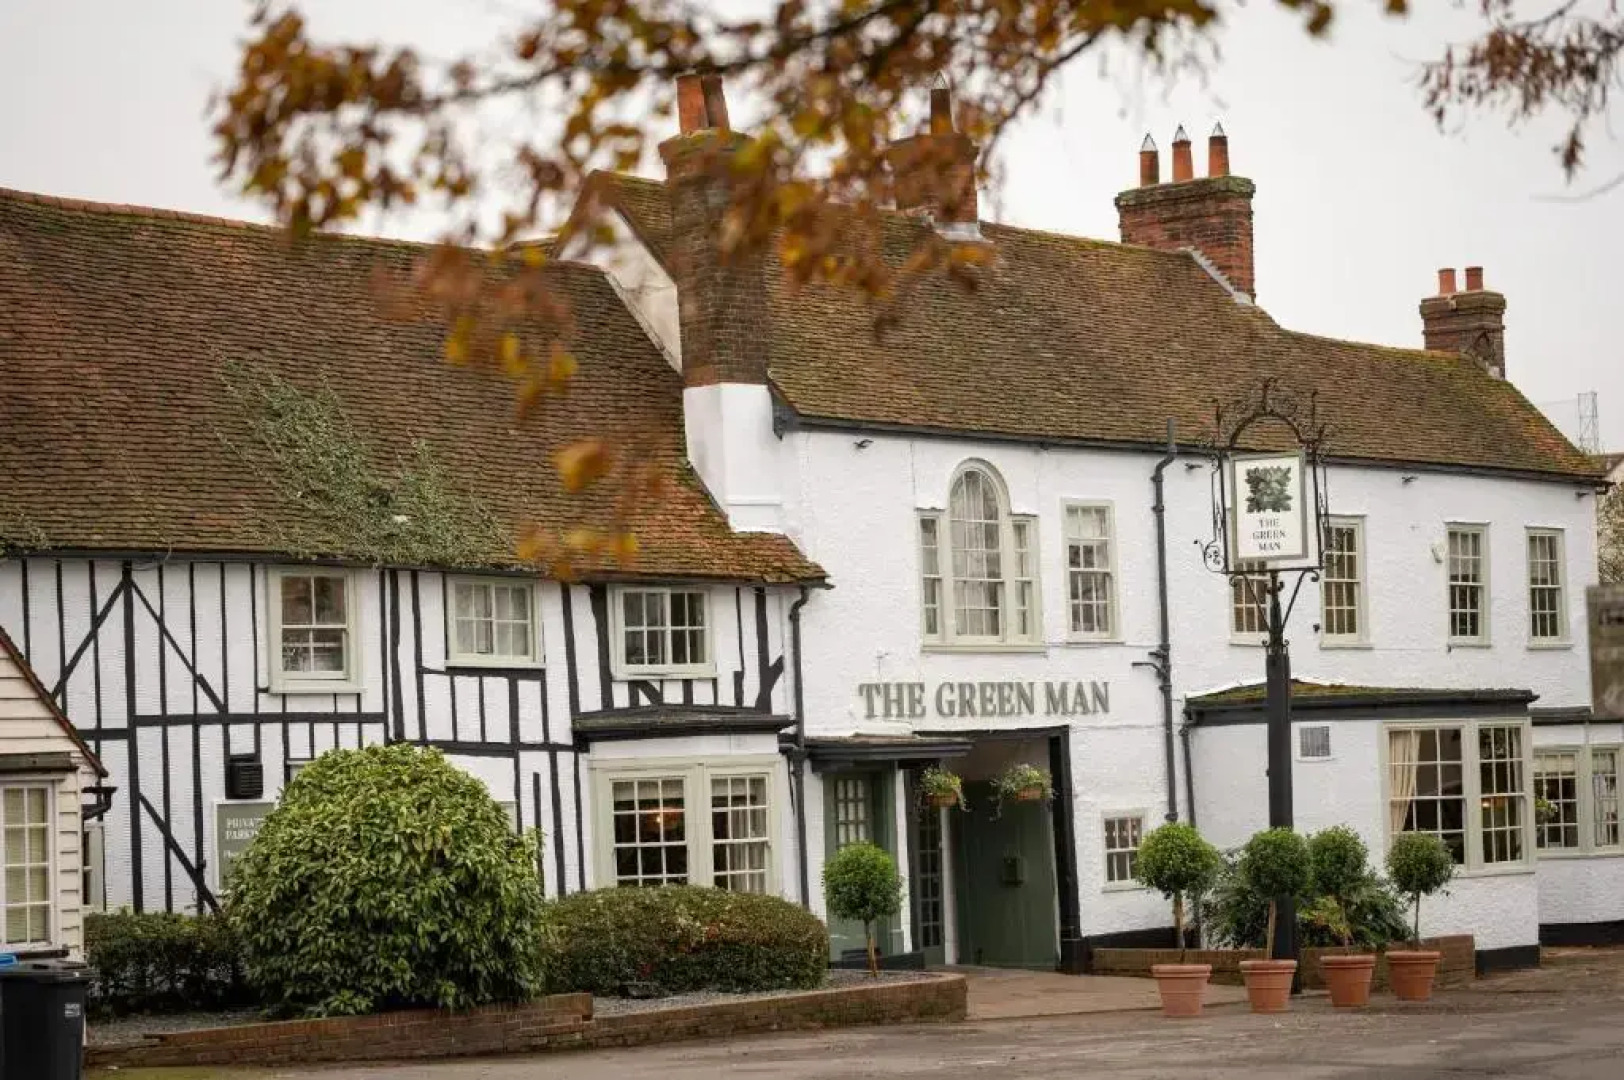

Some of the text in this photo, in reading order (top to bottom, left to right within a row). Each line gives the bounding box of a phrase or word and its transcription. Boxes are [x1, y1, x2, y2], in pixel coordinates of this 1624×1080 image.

[1258, 518, 1280, 528] THE
[1252, 530, 1286, 540] GREEN
[1258, 541, 1281, 551] MAN
[859, 681, 1111, 719] THE GREEN MAN
